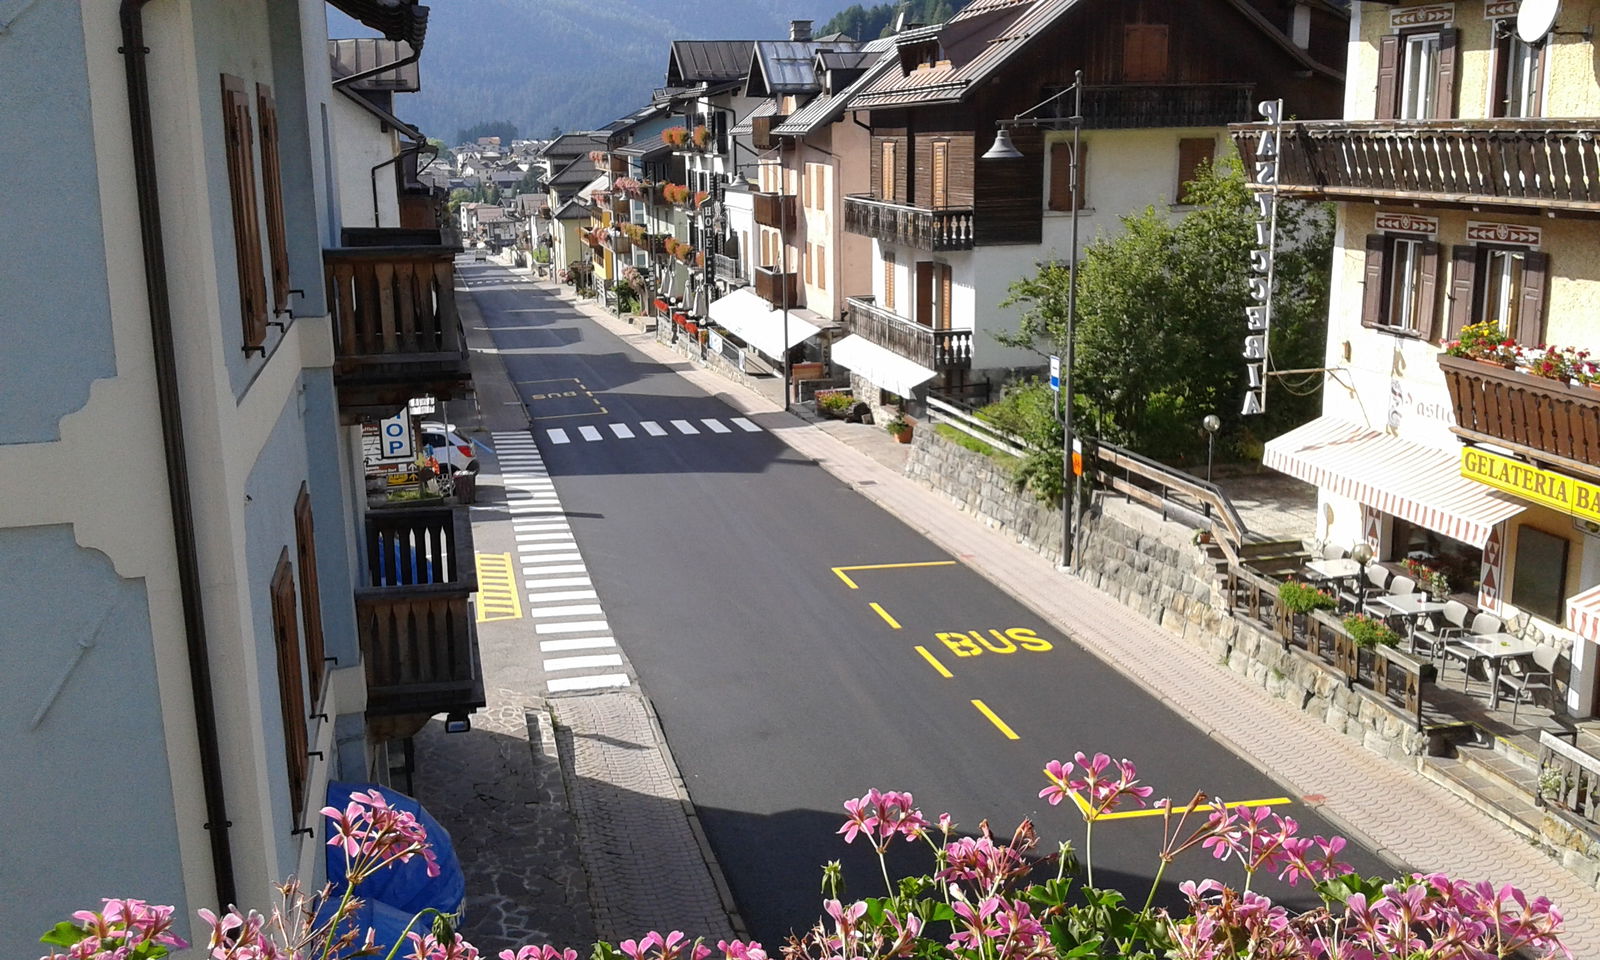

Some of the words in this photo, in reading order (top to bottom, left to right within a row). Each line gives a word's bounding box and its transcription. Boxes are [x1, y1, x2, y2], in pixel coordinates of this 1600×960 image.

[704, 206, 713, 258] HOTEL
[1465, 451, 1568, 503] GELATERIA
[1576, 486, 1600, 513] BA
[935, 628, 1053, 657] BUS
